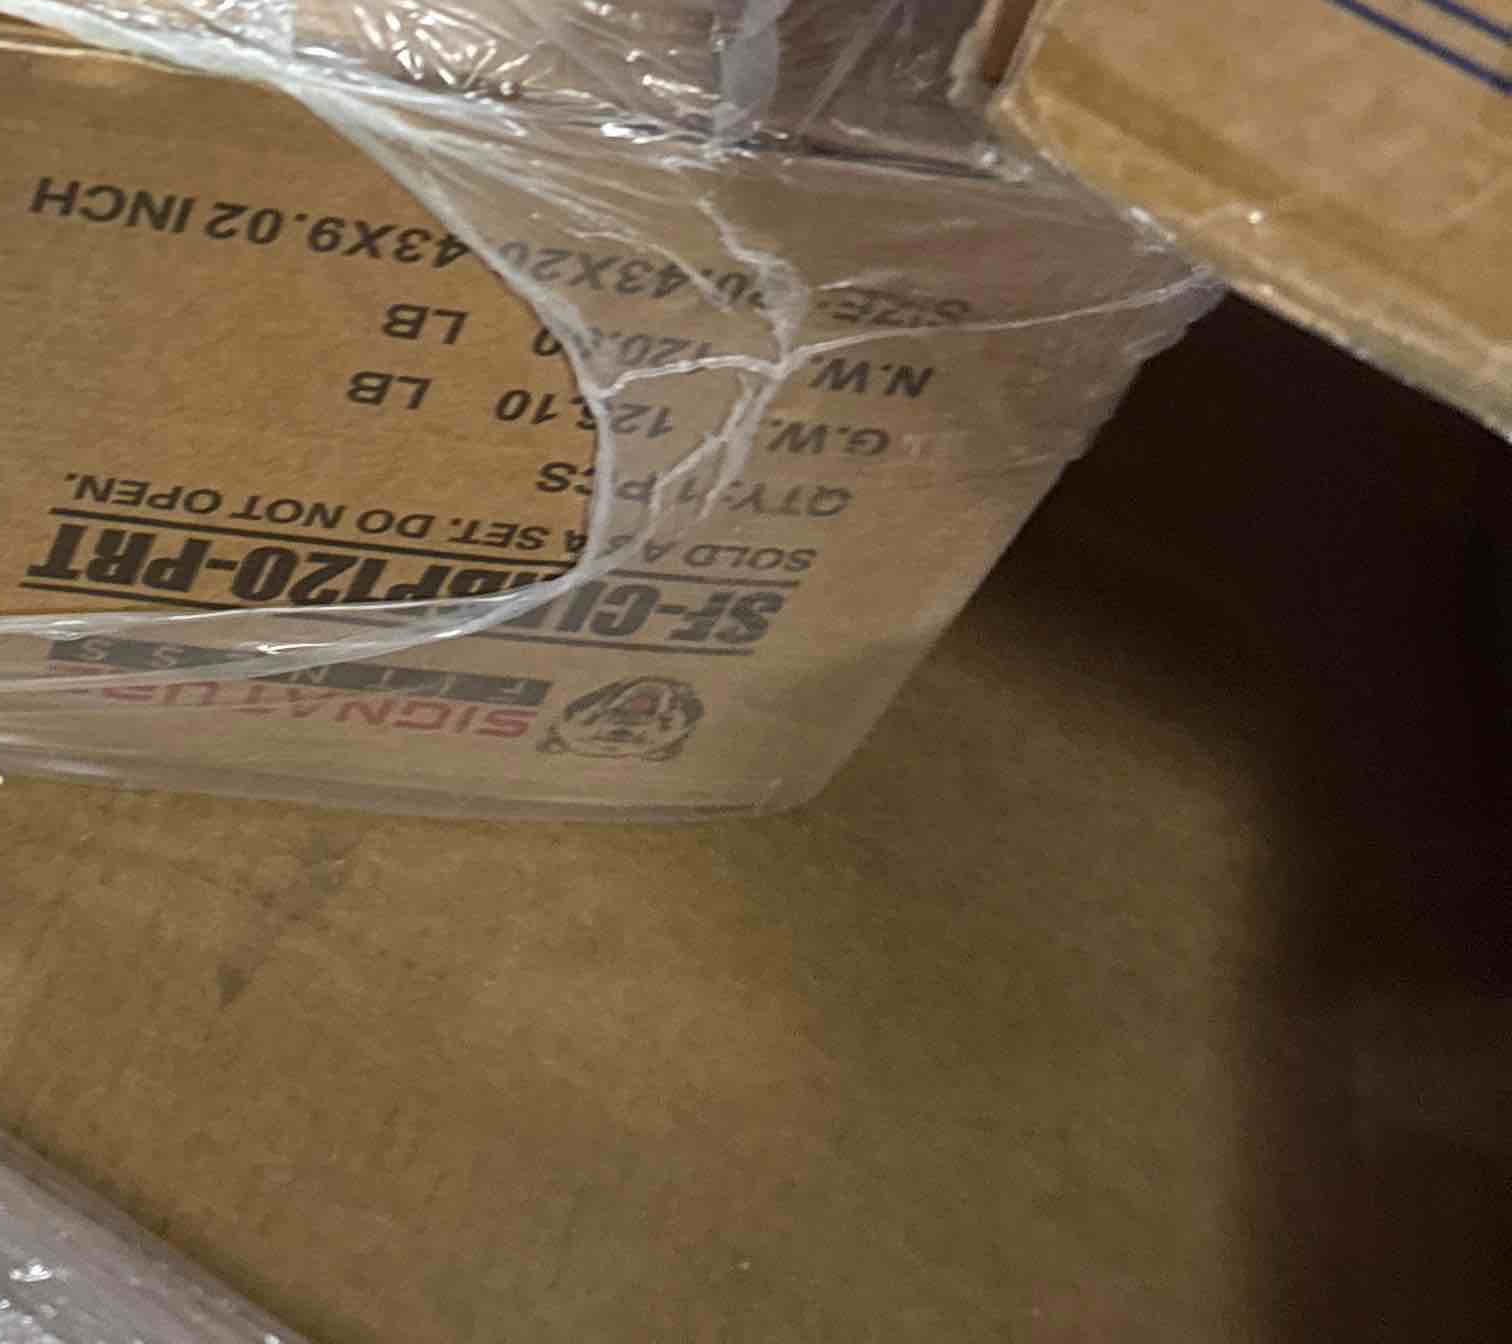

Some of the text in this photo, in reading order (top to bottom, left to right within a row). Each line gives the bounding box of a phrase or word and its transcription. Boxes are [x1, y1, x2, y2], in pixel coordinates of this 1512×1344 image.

[28, 177, 196, 234] INCH
[381, 303, 469, 345] LB
[346, 371, 432, 411] LB
[62, 472, 223, 515] OPEN.
[229, 495, 345, 529] NOT
[726, 480, 852, 518] QTY:
[355, 509, 436, 540] DO
[450, 517, 550, 551] SET.
[685, 544, 817, 573] SOLD
[78, 637, 526, 698] FITNSS
